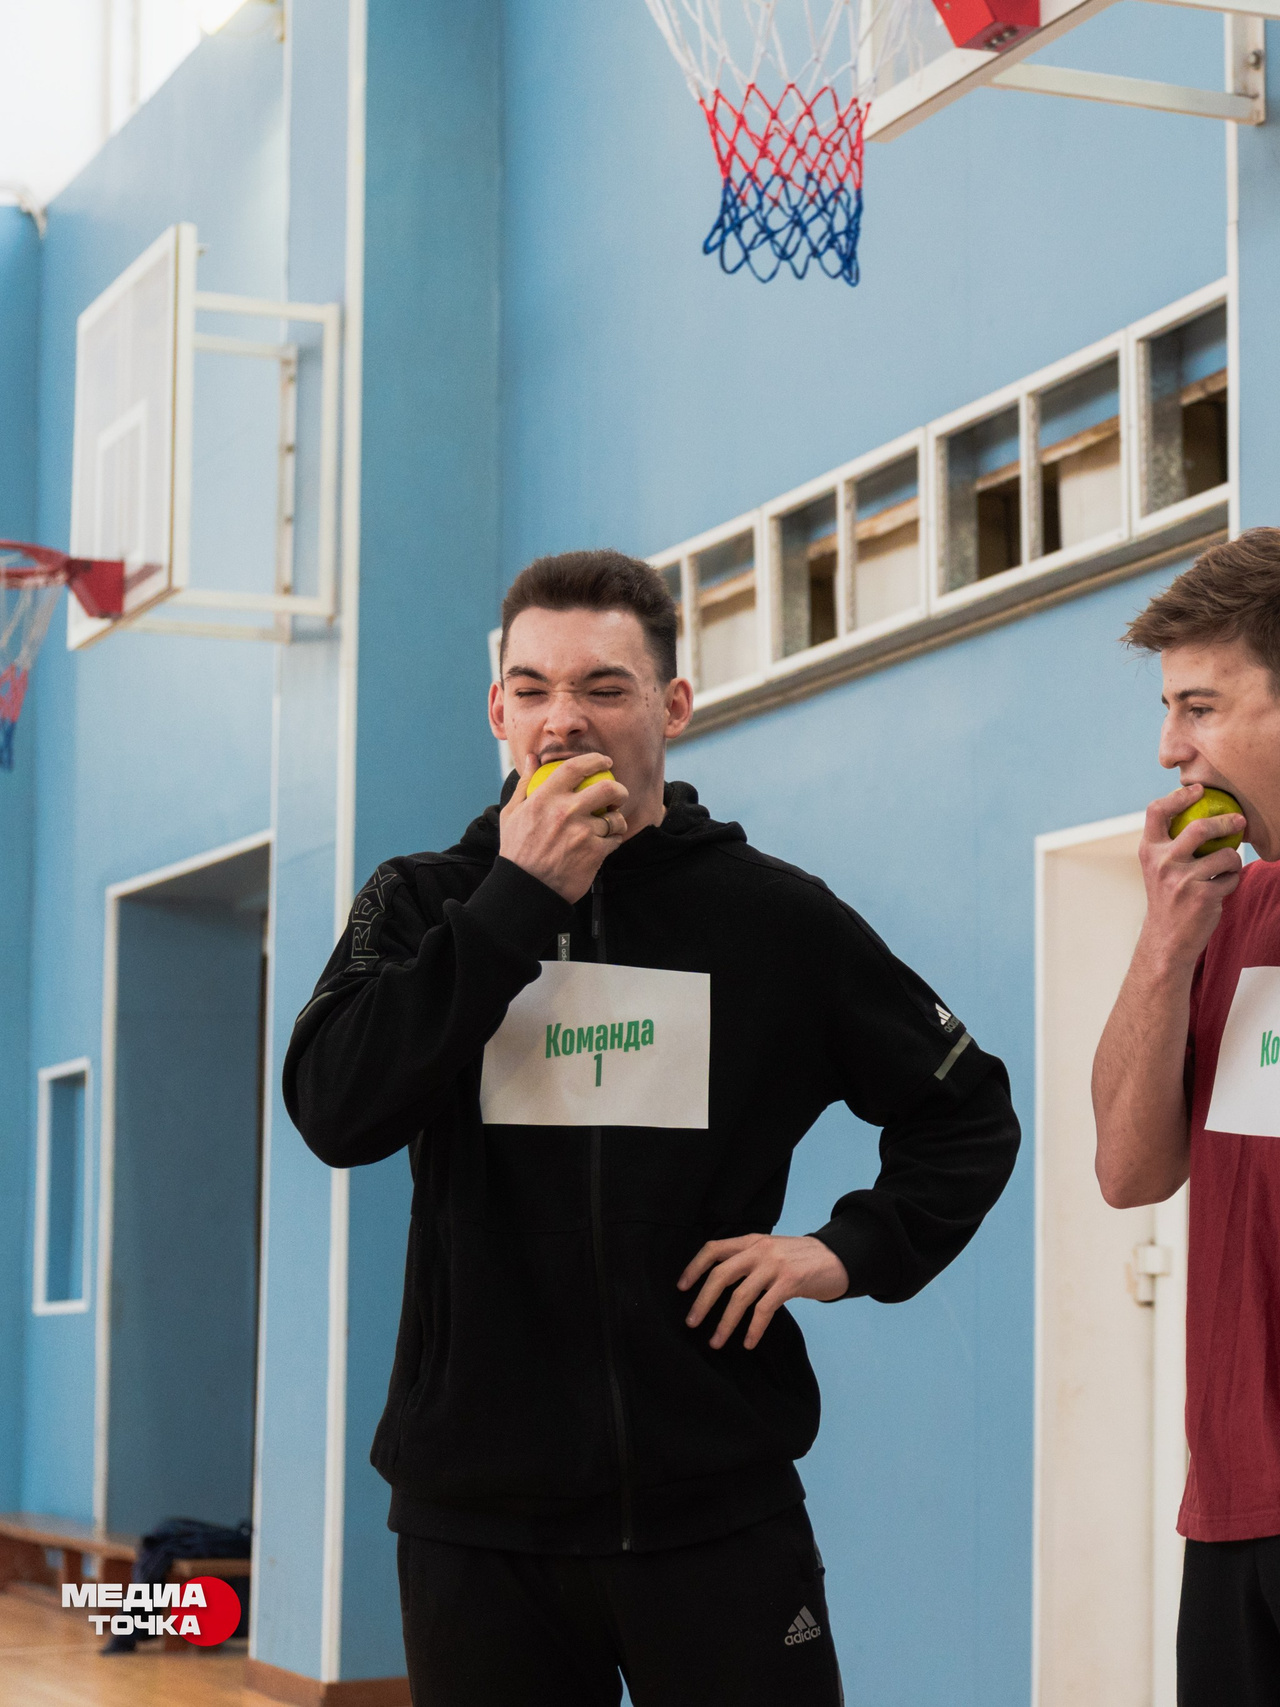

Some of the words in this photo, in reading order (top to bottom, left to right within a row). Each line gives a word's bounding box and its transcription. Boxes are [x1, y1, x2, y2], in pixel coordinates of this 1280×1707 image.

[545, 1019, 655, 1059] Команда
[594, 1053, 603, 1087] 1
[784, 1626, 821, 1646] adidas
